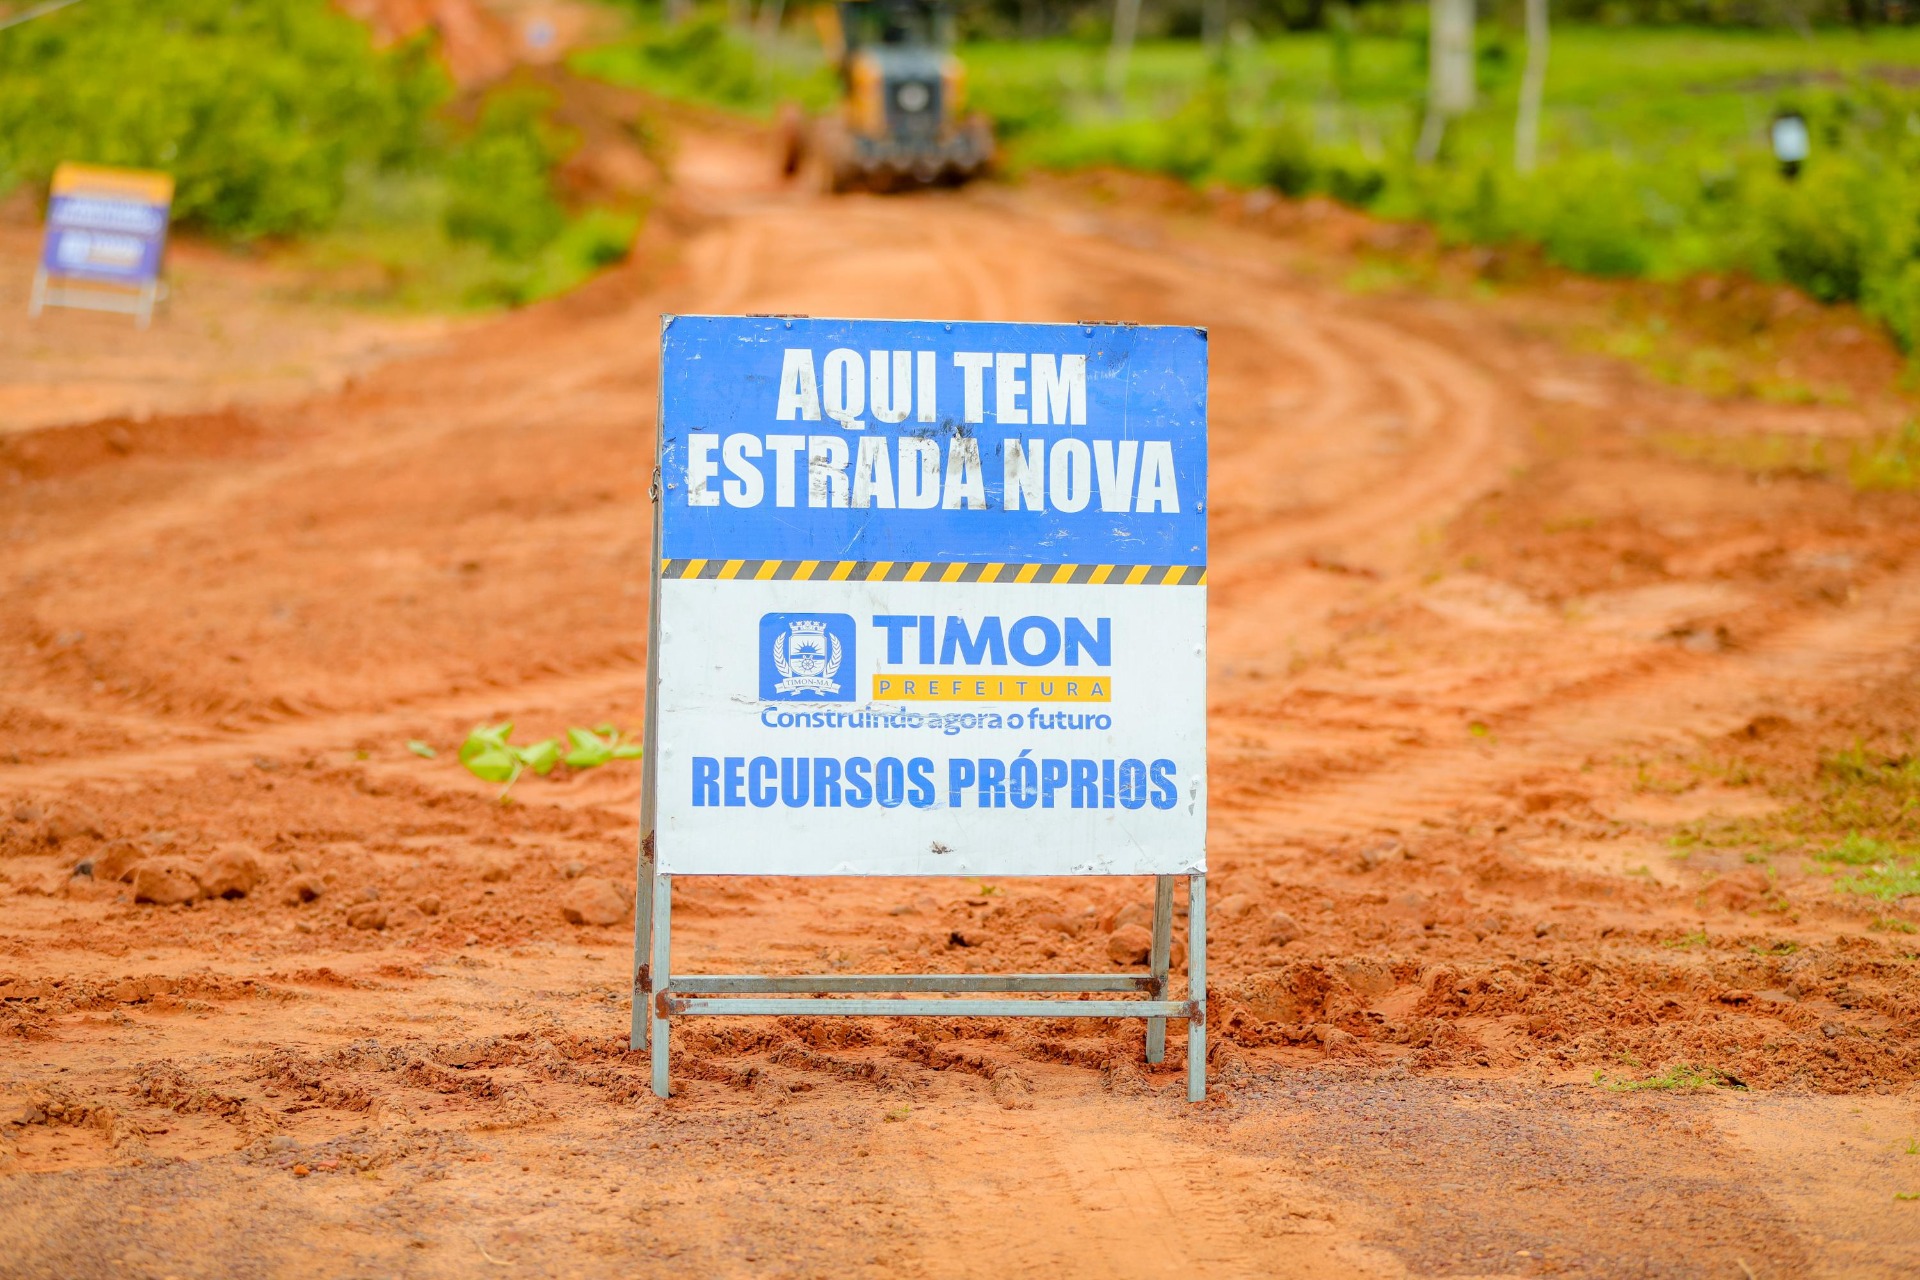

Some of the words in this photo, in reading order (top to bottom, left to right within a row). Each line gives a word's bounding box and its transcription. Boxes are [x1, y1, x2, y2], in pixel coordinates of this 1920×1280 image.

[776, 347, 936, 430] AQUI
[954, 351, 1087, 426] TEM
[687, 432, 987, 510] ESTRADA
[1003, 437, 1181, 514] NOVA
[872, 615, 1112, 667] TIMON
[785, 678, 830, 687] TIMON-MA
[879, 679, 1104, 697] PREFEITURA
[760, 706, 922, 729] Construindo
[926, 713, 1003, 736] agora
[1006, 713, 1025, 730] o
[1027, 706, 1112, 731] futuro
[691, 755, 936, 809] RECURSOS
[948, 748, 1178, 810] PRÓPRIOS
